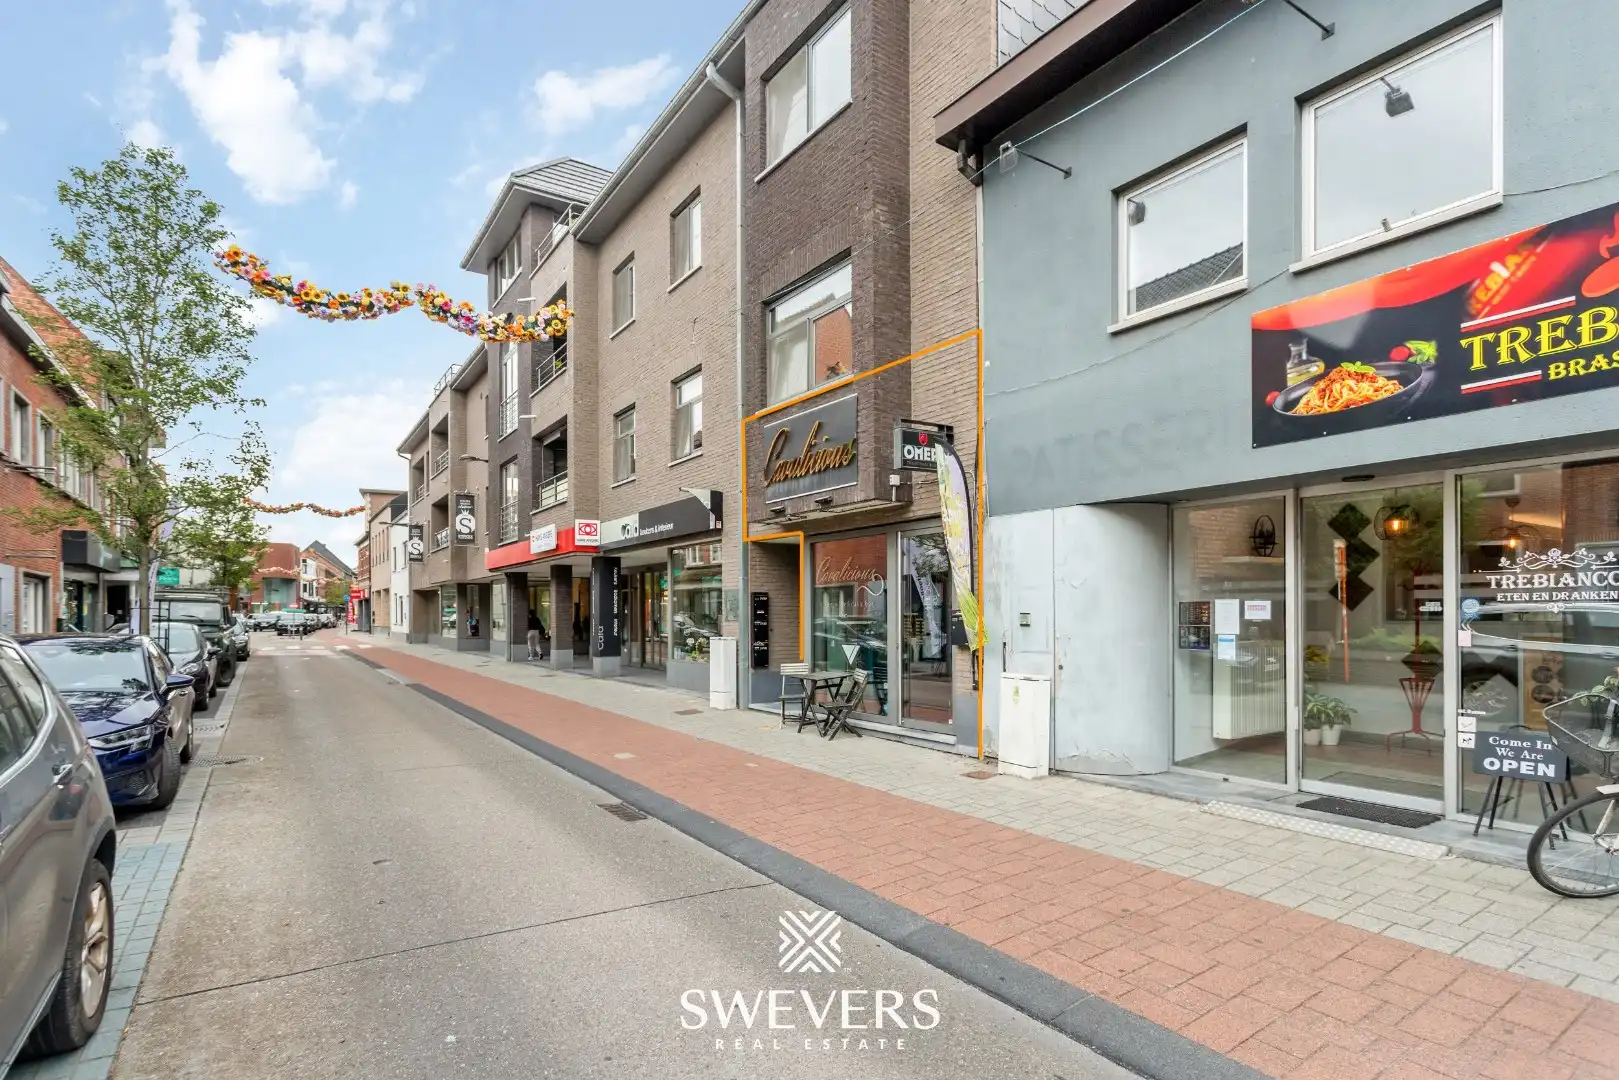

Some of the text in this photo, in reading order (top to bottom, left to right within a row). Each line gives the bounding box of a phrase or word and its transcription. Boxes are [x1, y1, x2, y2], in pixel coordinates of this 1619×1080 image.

[1460, 306, 1619, 371] TREB
[1496, 590, 1619, 601] ETEN EN DRANKEN
[1488, 736, 1553, 750] Come In
[1495, 747, 1544, 760] We Are
[1483, 757, 1556, 777] OPEN
